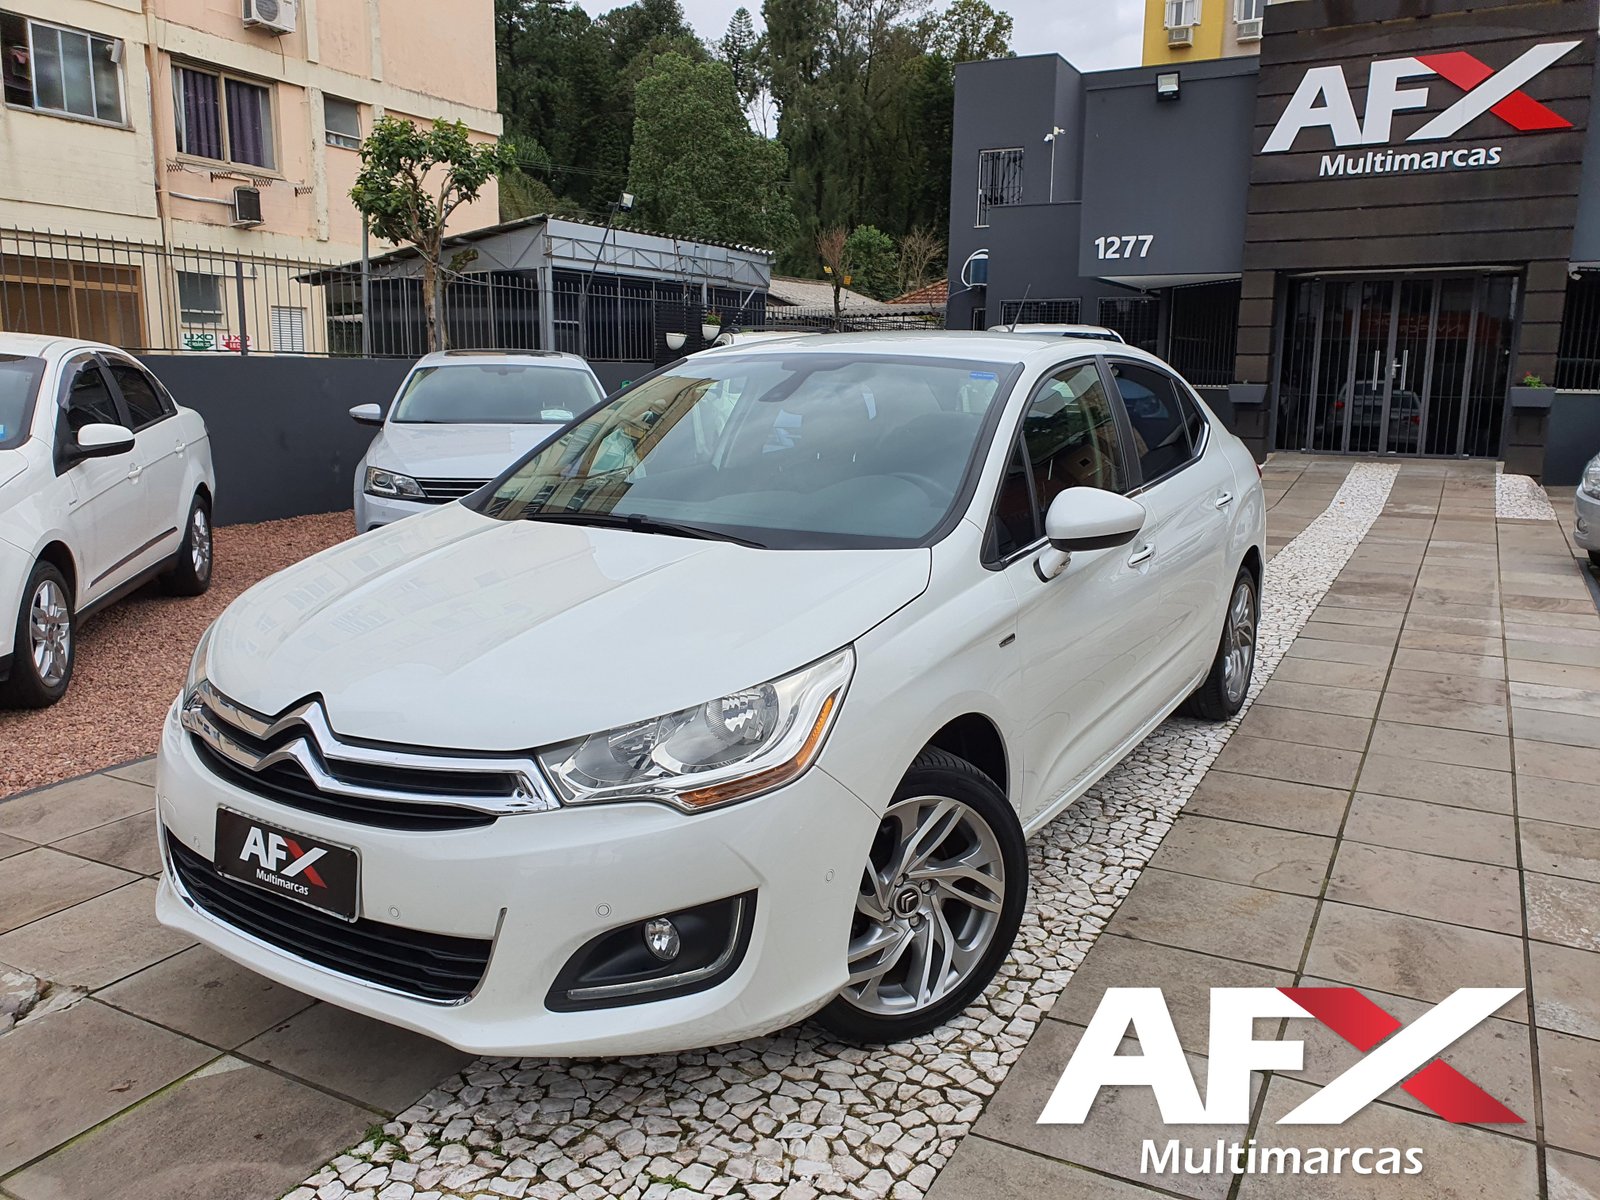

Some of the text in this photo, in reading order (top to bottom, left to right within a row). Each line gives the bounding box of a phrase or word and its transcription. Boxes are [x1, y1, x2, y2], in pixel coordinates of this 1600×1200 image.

[1261, 40, 1583, 153] AFX
[1319, 146, 1502, 177] Multimarcas
[1095, 235, 1154, 259] 1277
[239, 826, 328, 889] AFX
[256, 868, 310, 896] Multimarcas
